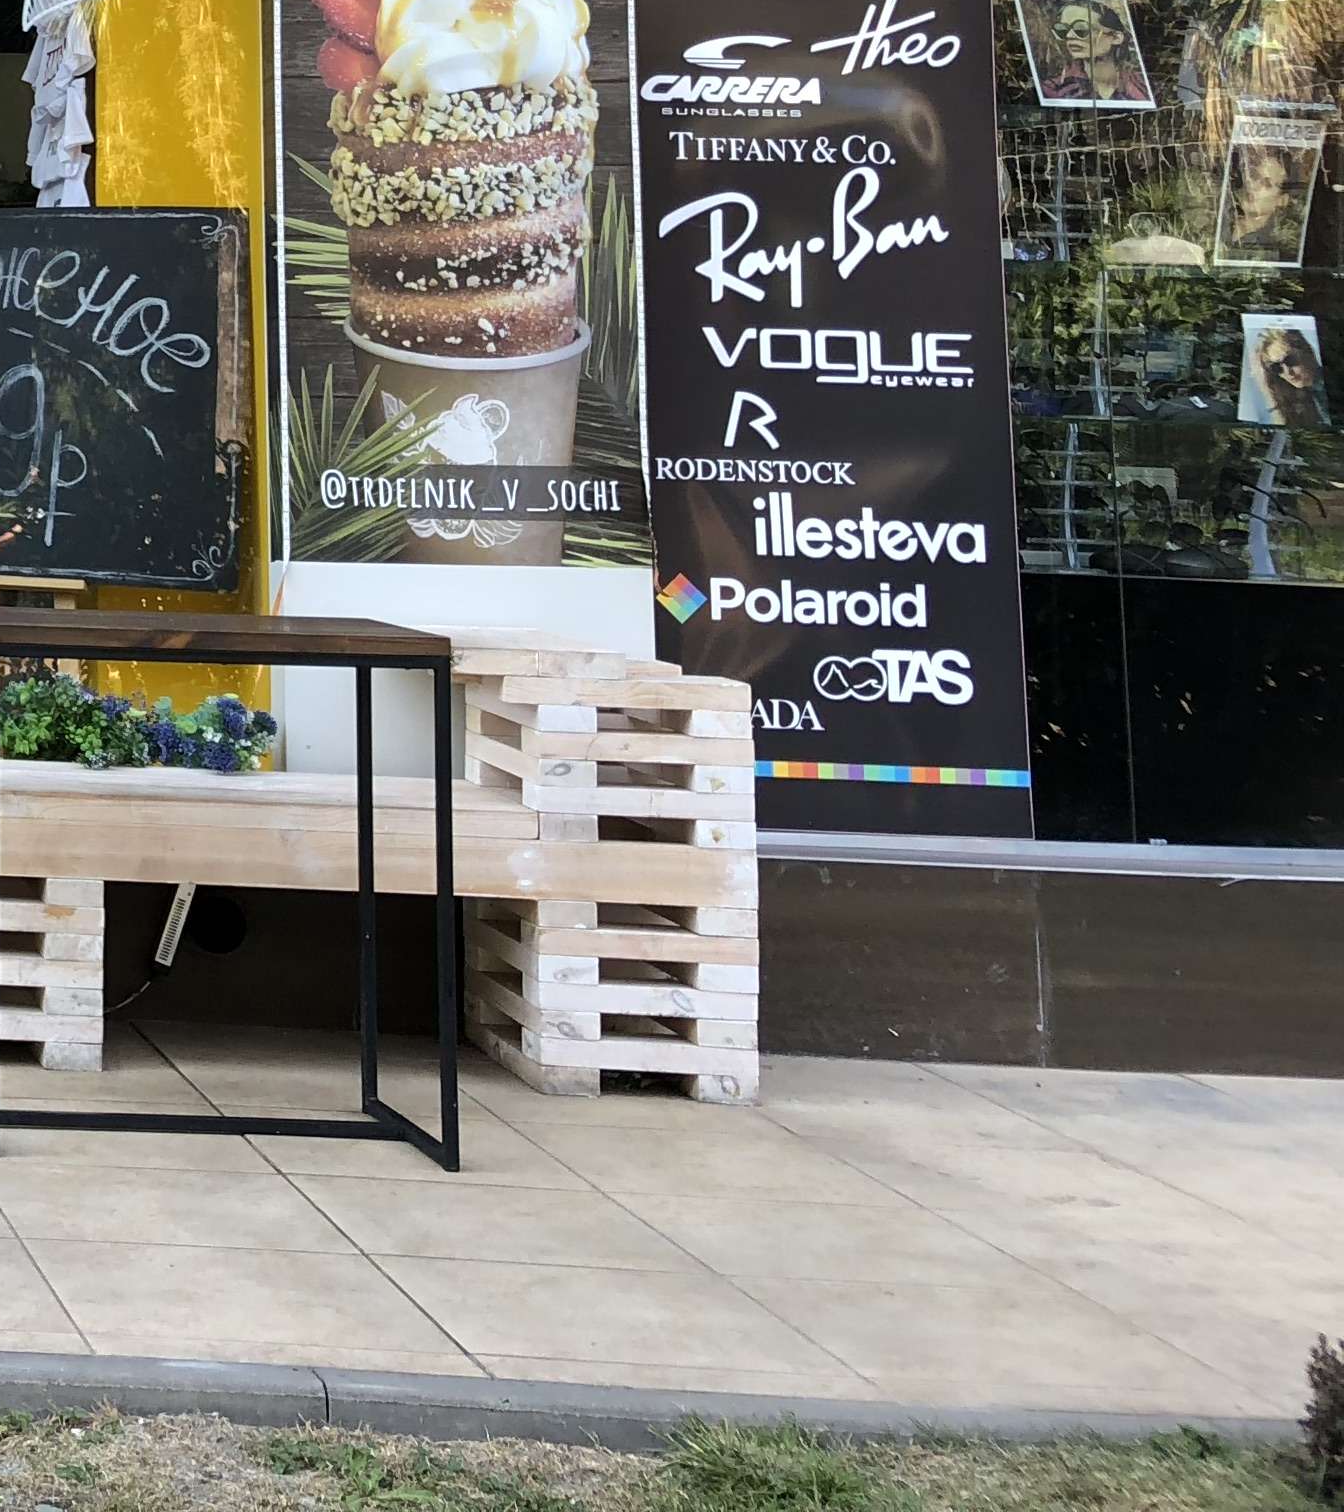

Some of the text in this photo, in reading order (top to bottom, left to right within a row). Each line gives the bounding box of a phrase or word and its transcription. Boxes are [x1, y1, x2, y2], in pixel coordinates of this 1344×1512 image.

[640, 74, 822, 105] CARRERA
[661, 106, 803, 118] SUNGLASSES
[669, 130, 808, 163] TIFFANY
[655, 457, 856, 486] RODENSTOCK
[752, 491, 987, 564] illesteva
[709, 576, 928, 629] Polaroid
[750, 697, 826, 732] ADA
